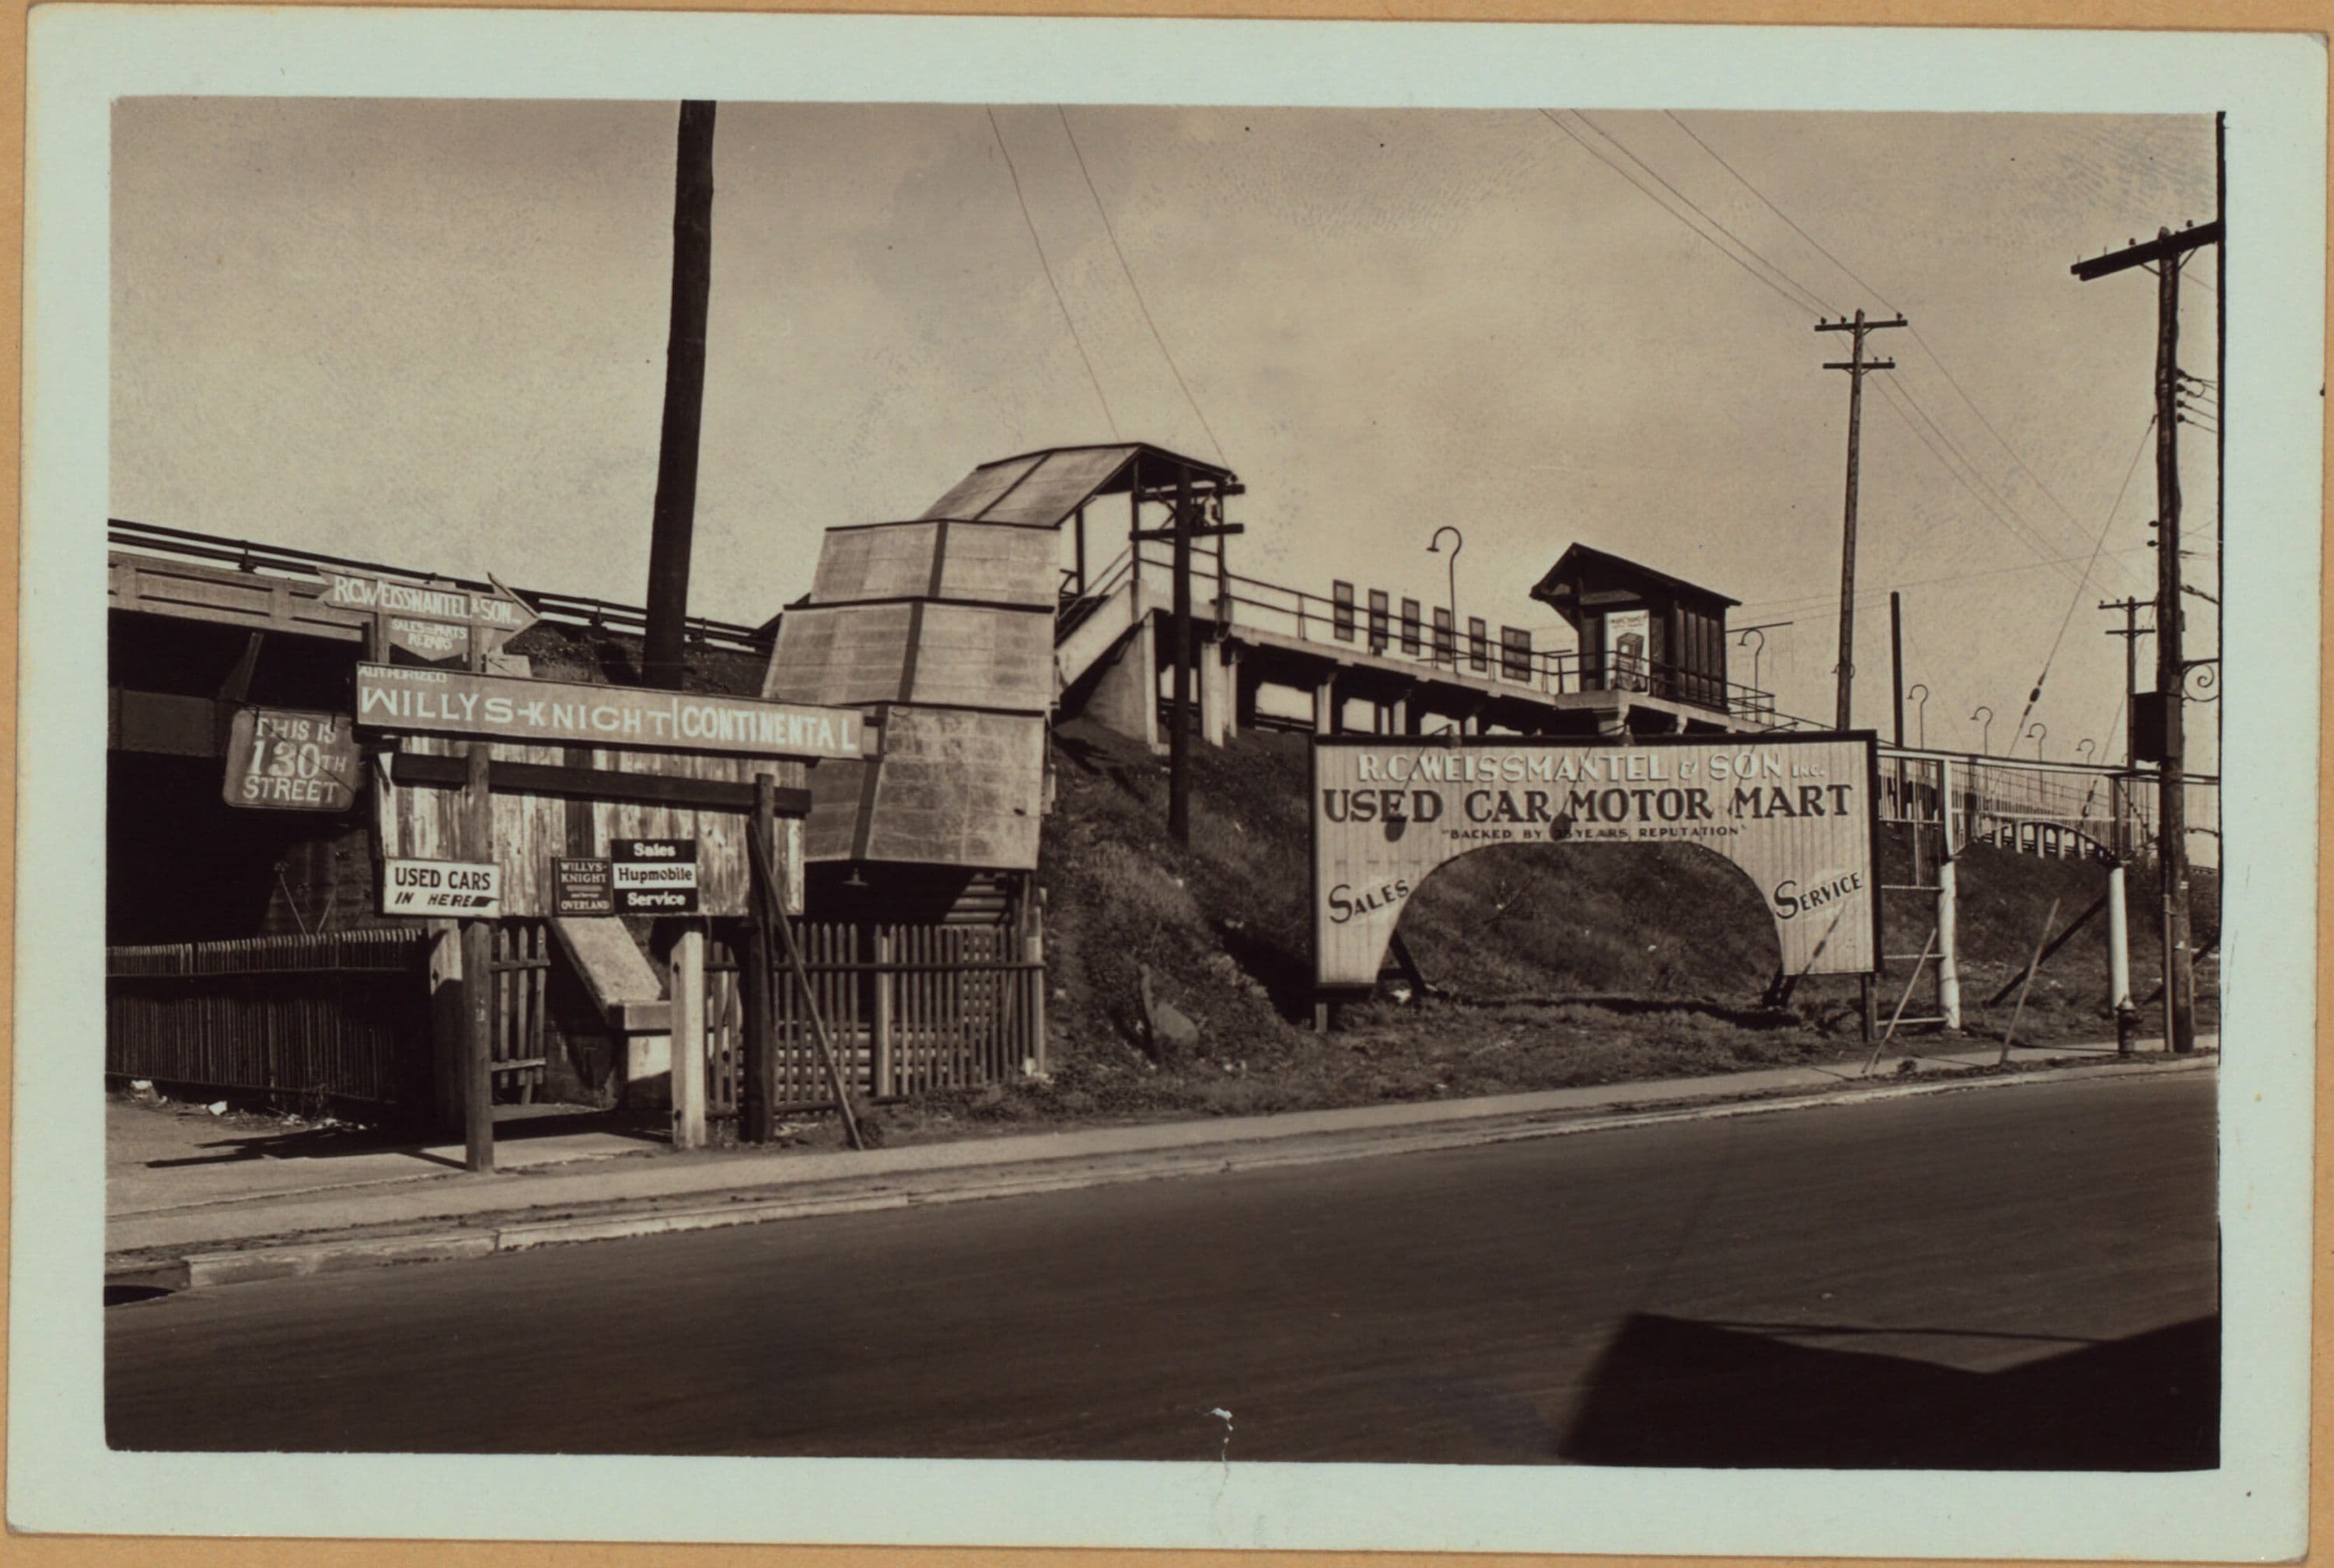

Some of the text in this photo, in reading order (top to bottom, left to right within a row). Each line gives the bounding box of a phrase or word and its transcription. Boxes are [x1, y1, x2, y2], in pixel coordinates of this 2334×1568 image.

[480, 599, 512, 624] SON
[391, 619, 467, 641] SALES PARTS
[358, 665, 447, 683] AUTHORIZED
[255, 718, 337, 744] THIS IS
[681, 704, 856, 750] CONTINENTAL
[1710, 752, 1782, 781] SON
[243, 775, 340, 803] STREET
[1322, 784, 1854, 823] USED CAR MOTOR MART
[1523, 829, 1543, 840] BY
[1574, 827, 1628, 839] YEARS
[633, 842, 676, 857] Sales
[560, 861, 607, 872] WILLYS-
[617, 867, 693, 884] Hupmobile
[395, 867, 491, 891] USED CARS
[560, 872, 606, 884] KNIGHT
[395, 892, 473, 908] IN HERE
[561, 899, 610, 910] OVERLAND
[627, 891, 686, 906] Service
